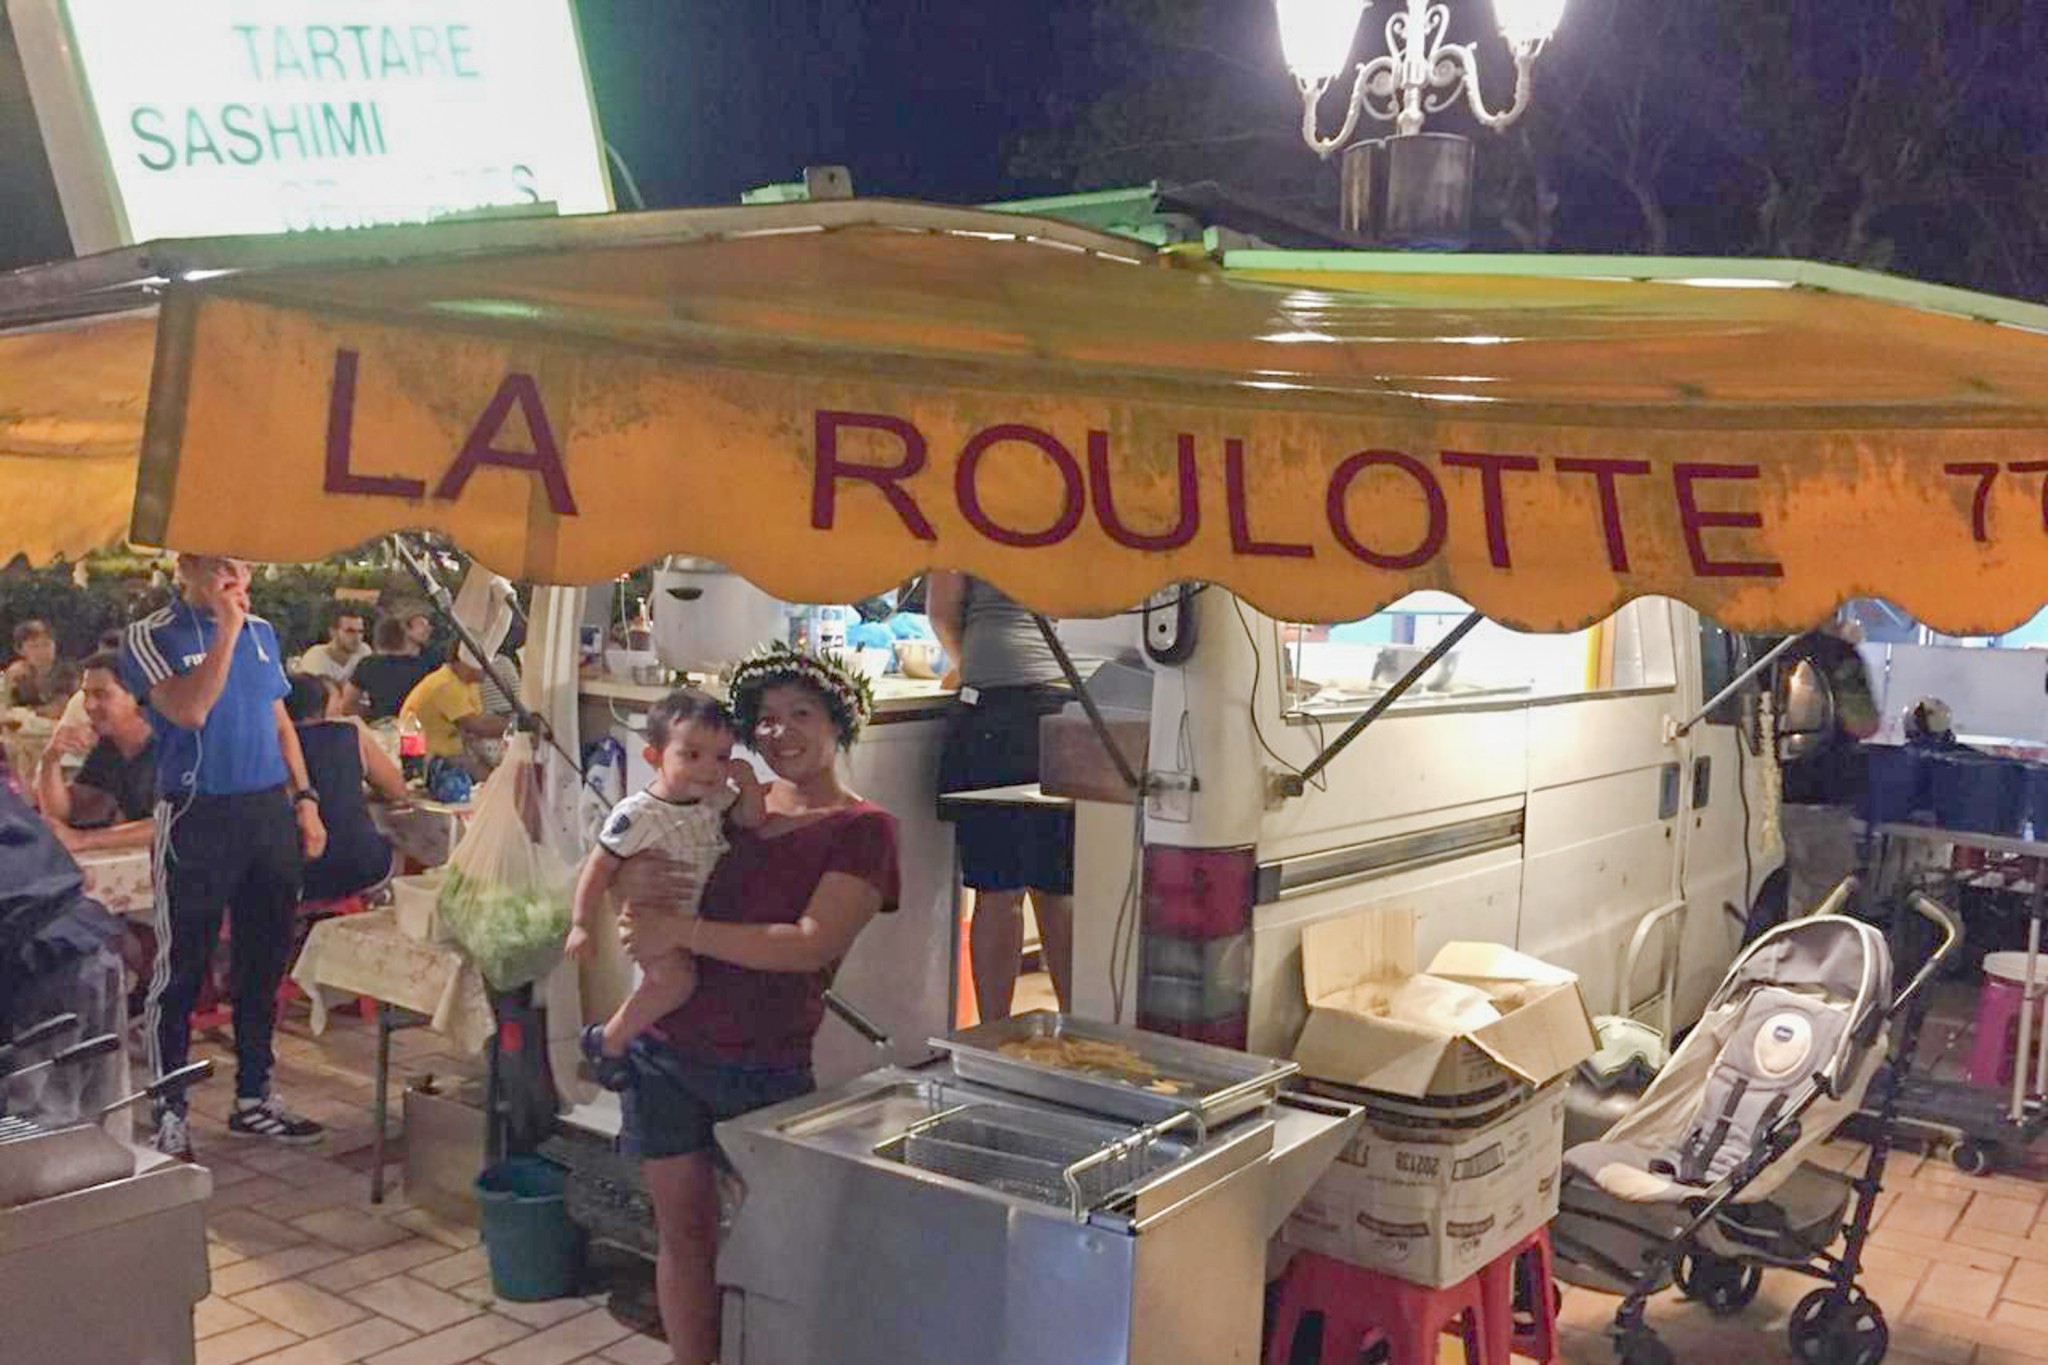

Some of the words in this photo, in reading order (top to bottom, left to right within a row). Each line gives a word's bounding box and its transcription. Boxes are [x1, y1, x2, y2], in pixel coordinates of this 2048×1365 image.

[232, 23, 481, 81] TARTARE
[130, 101, 388, 171] SASHIMI
[323, 348, 579, 516] LA
[811, 409, 1785, 577] ROULOTTE
